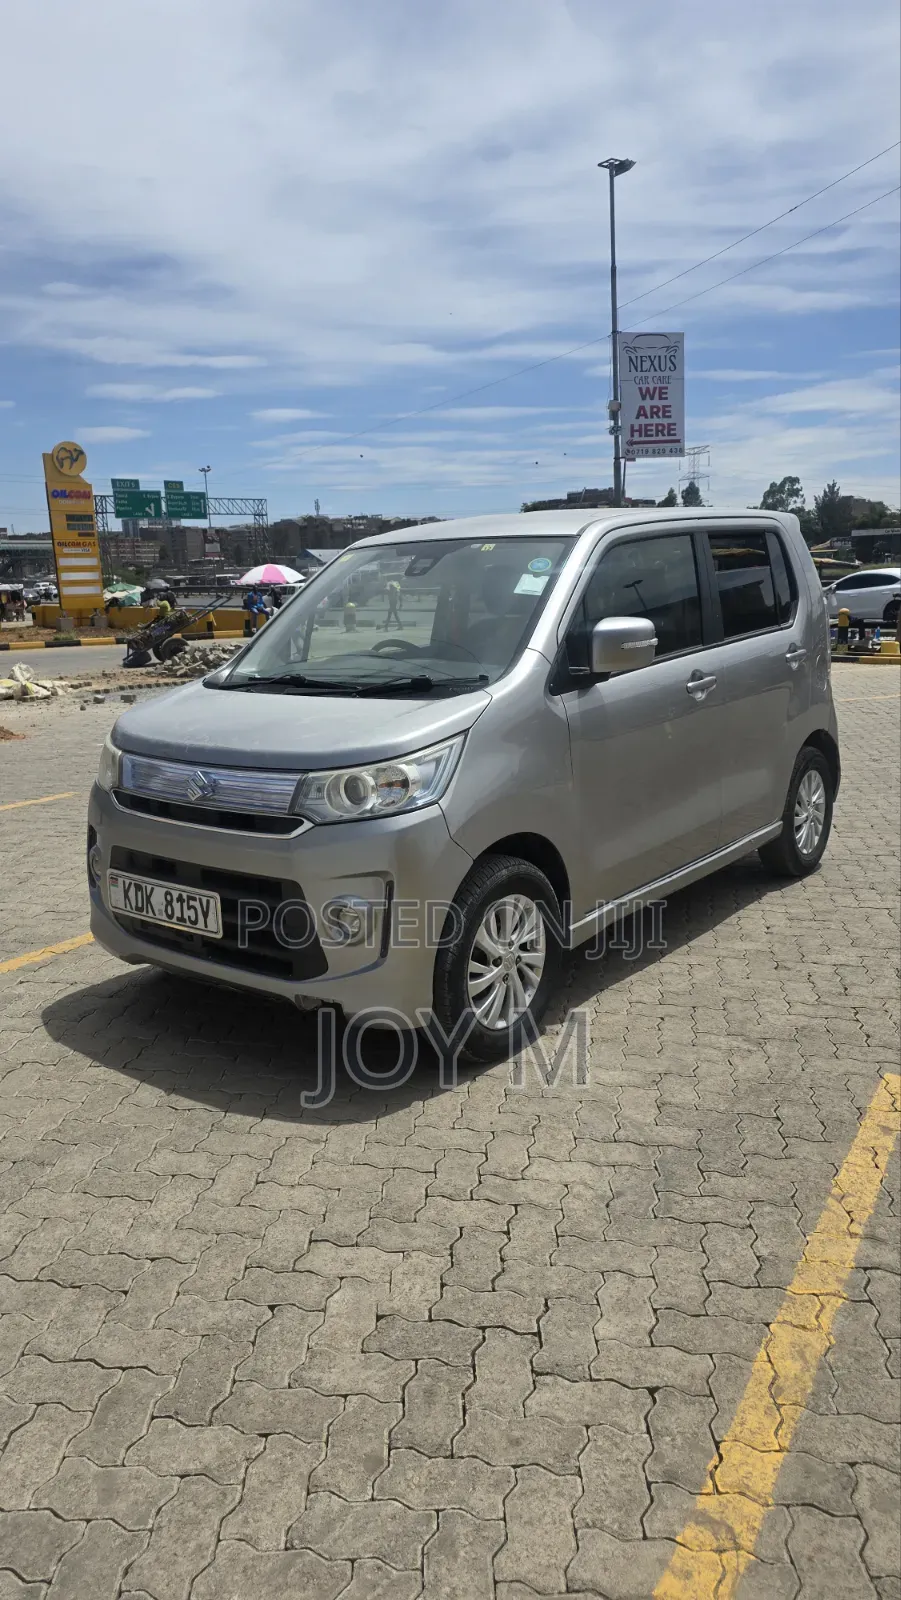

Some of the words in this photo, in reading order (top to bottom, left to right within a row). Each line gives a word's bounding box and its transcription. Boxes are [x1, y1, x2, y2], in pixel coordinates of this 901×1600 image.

[628, 355, 676, 372] NEXUS
[633, 375, 650, 385] CAR
[651, 375, 672, 385] CARE
[638, 386, 669, 401] WE
[635, 404, 672, 420] ARE
[630, 422, 677, 438] HERE
[631, 447, 649, 455] 0719
[116, 480, 130, 488] EXIT
[51, 488, 91, 500] OILCOM
[122, 879, 157, 916] KDK
[163, 890, 211, 929] 815Y
